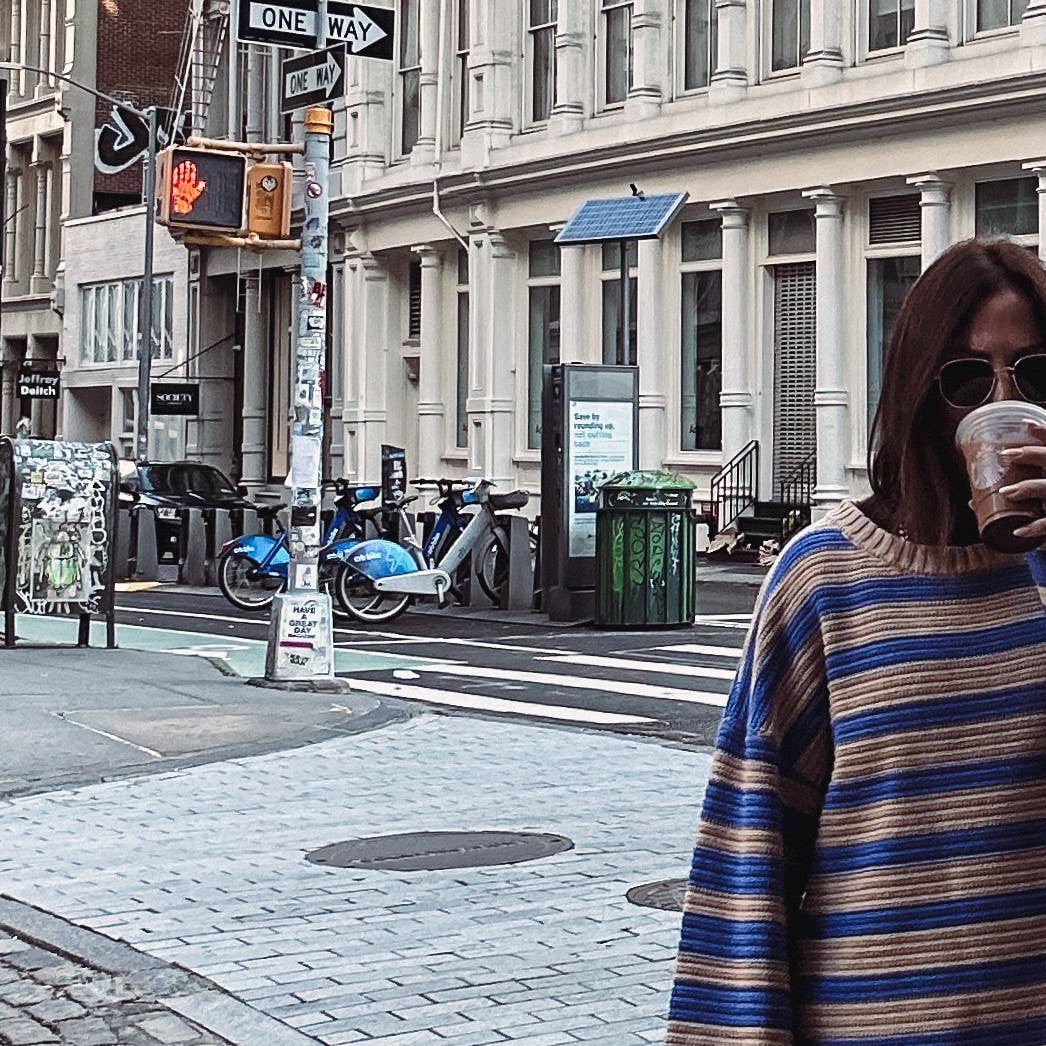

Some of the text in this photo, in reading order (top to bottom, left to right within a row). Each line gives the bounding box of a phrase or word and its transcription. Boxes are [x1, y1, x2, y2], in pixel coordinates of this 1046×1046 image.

[262, 7, 373, 42] ONE WAY
[290, 63, 336, 94] ONE WAY
[20, 386, 56, 396] Deitch
[293, 606, 316, 614] HAVE
